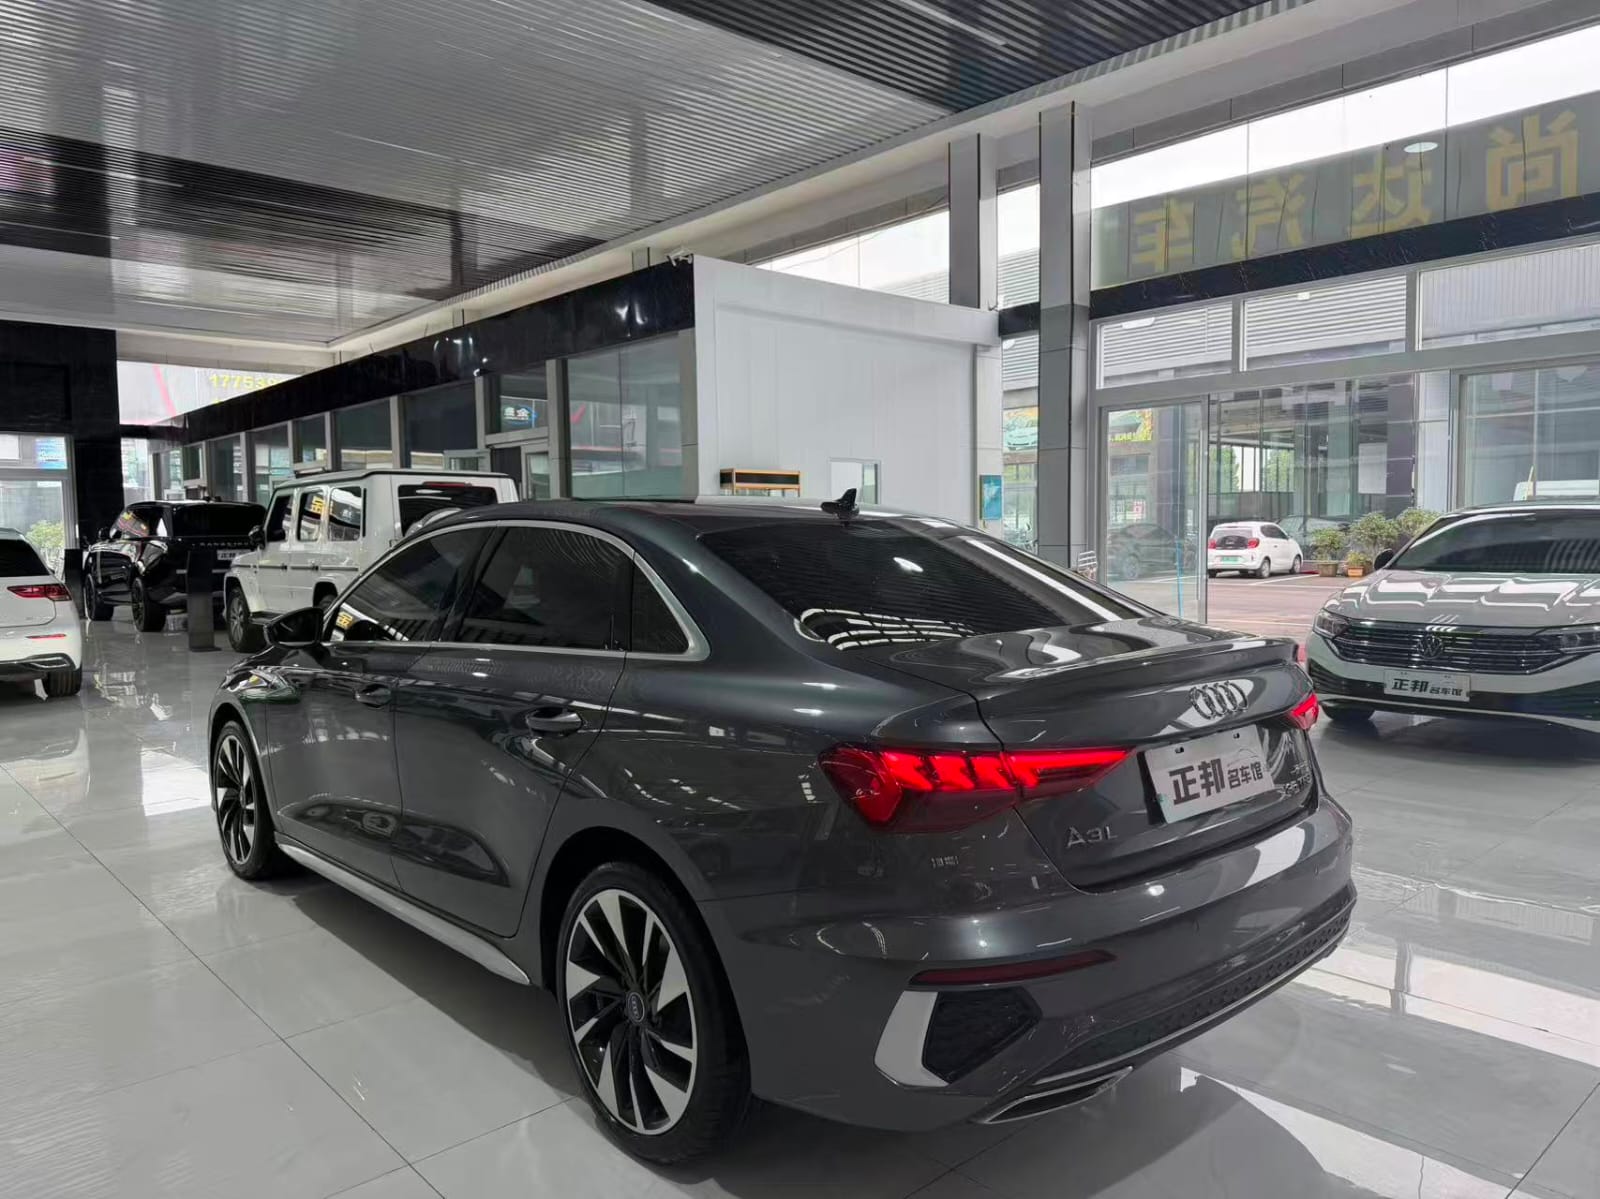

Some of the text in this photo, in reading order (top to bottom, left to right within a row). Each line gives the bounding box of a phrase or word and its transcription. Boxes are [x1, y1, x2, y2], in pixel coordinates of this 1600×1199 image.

[1168, 757, 1264, 806] 正邦名车馆
[1066, 825, 1119, 848] A3L
